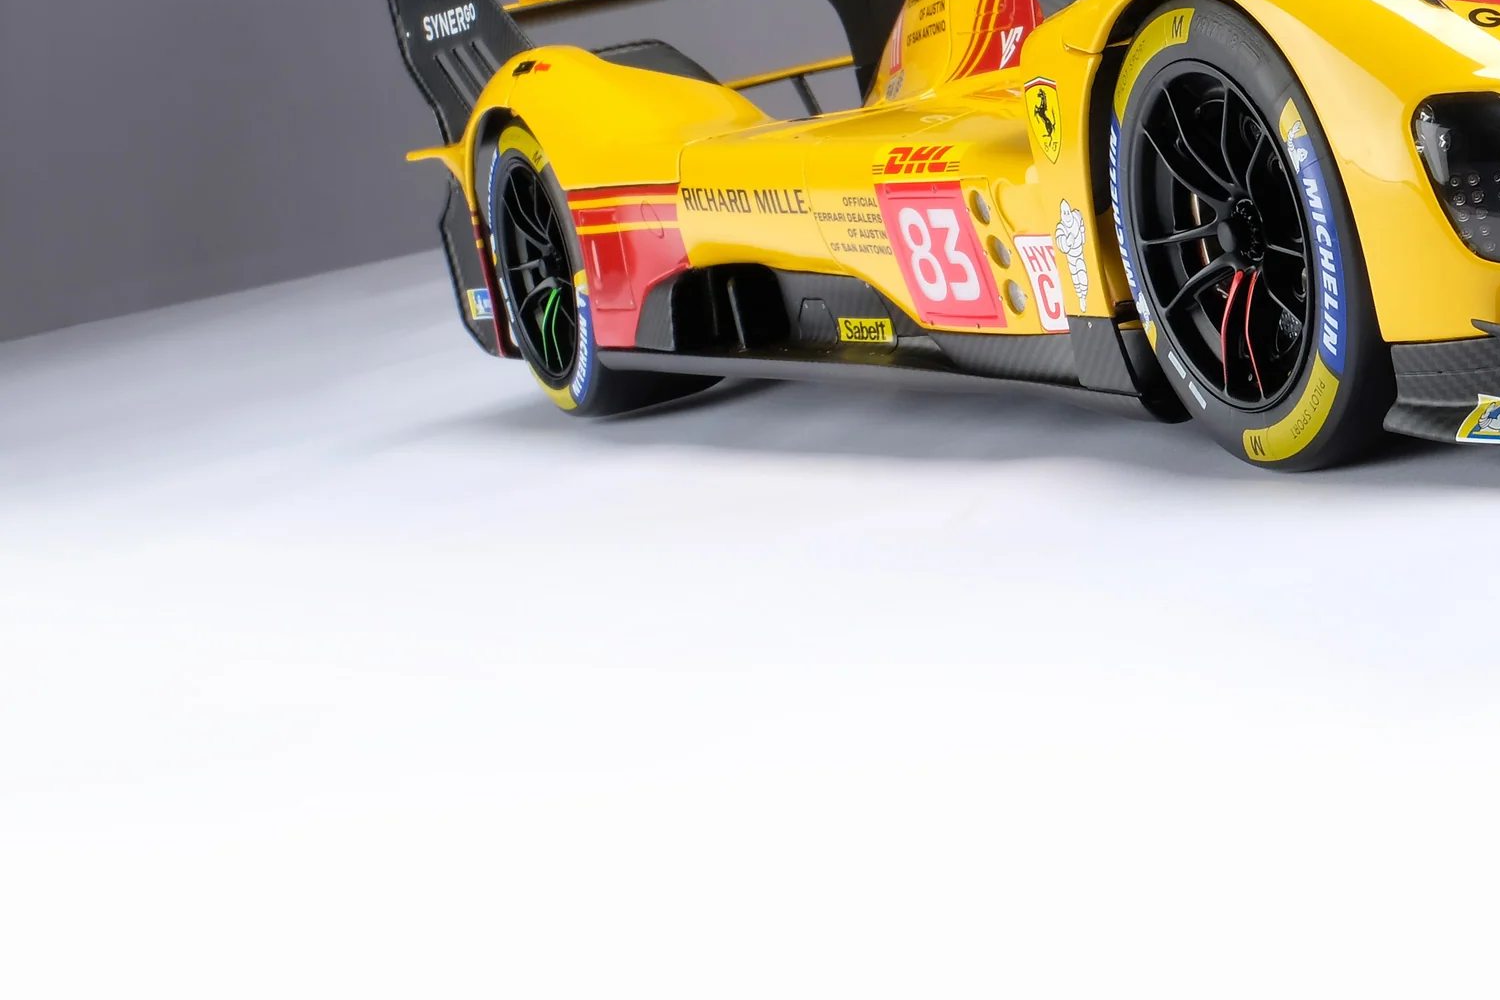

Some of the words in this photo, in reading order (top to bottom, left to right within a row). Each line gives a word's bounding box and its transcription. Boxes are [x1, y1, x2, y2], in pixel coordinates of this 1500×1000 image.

[926, 0, 946, 16] AUSTIN
[1171, 15, 1184, 38] M
[884, 146, 954, 174] DHL
[681, 187, 752, 213] RICHARD
[753, 189, 808, 214] MILLE
[842, 197, 878, 208] OFFICIAL
[1109, 125, 1137, 288] MICHELIN
[813, 212, 846, 222] FERRARI
[846, 213, 883, 224] DEALERS
[847, 228, 857, 238] OF
[859, 229, 889, 239] AUSTIN
[831, 242, 841, 251] OF
[841, 243, 858, 253] SAN
[859, 244, 893, 255] ANTONIO
[898, 207, 980, 303] 83
[1302, 178, 1340, 356] MICHELIN
[844, 320, 886, 341] Sabelt
[1309, 378, 1326, 412] PILOT
[1290, 410, 1312, 439] SPORT
